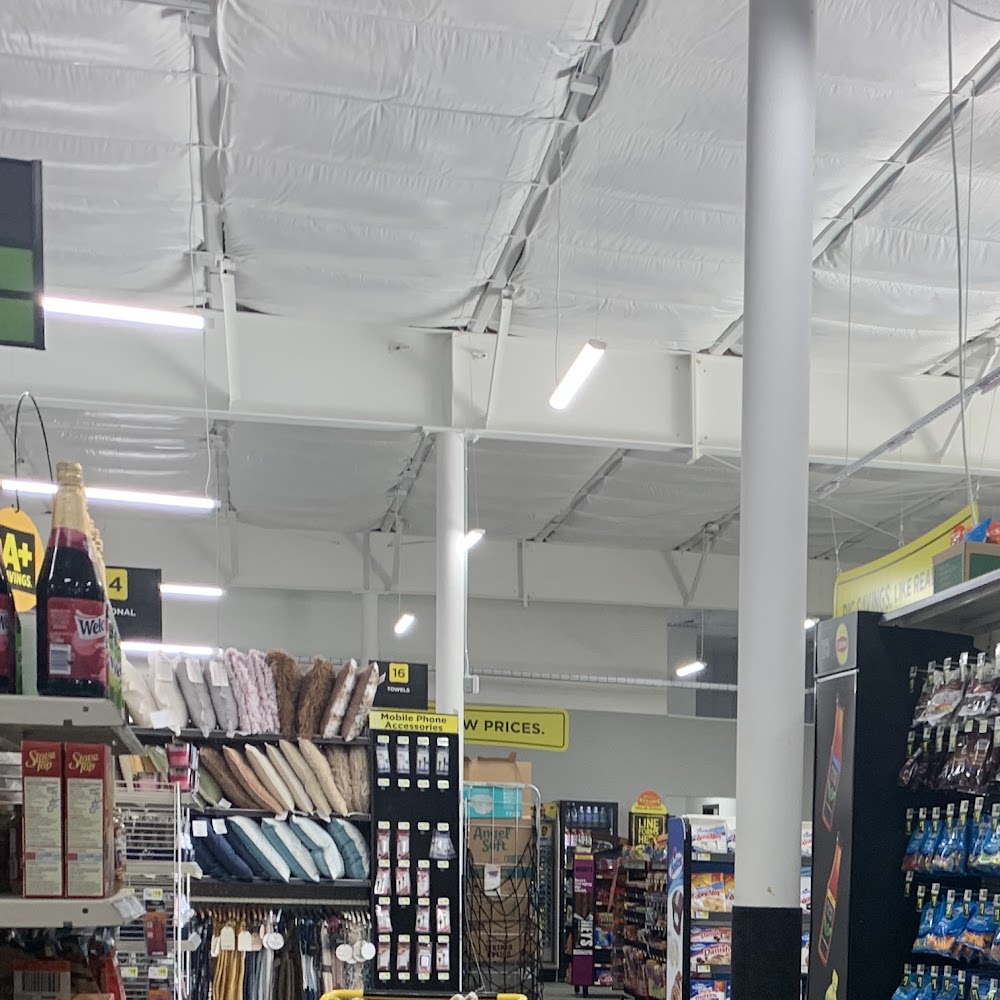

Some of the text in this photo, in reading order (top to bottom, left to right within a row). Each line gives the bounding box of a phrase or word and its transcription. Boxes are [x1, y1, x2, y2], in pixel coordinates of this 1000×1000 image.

[915, 569, 930, 592] REA
[393, 669, 405, 678] 16
[381, 713, 447, 723] Mobile Phone
[385, 723, 443, 732] Accessories
[464, 720, 545, 735] W PRICES.
[25, 750, 56, 768] Stove
[68, 752, 98, 769] Stove
[37, 760, 52, 772] Top
[80, 762, 95, 773] Top
[639, 818, 659, 828] LINE
[473, 827, 511, 840] Angel
[482, 838, 507, 853] Soft
